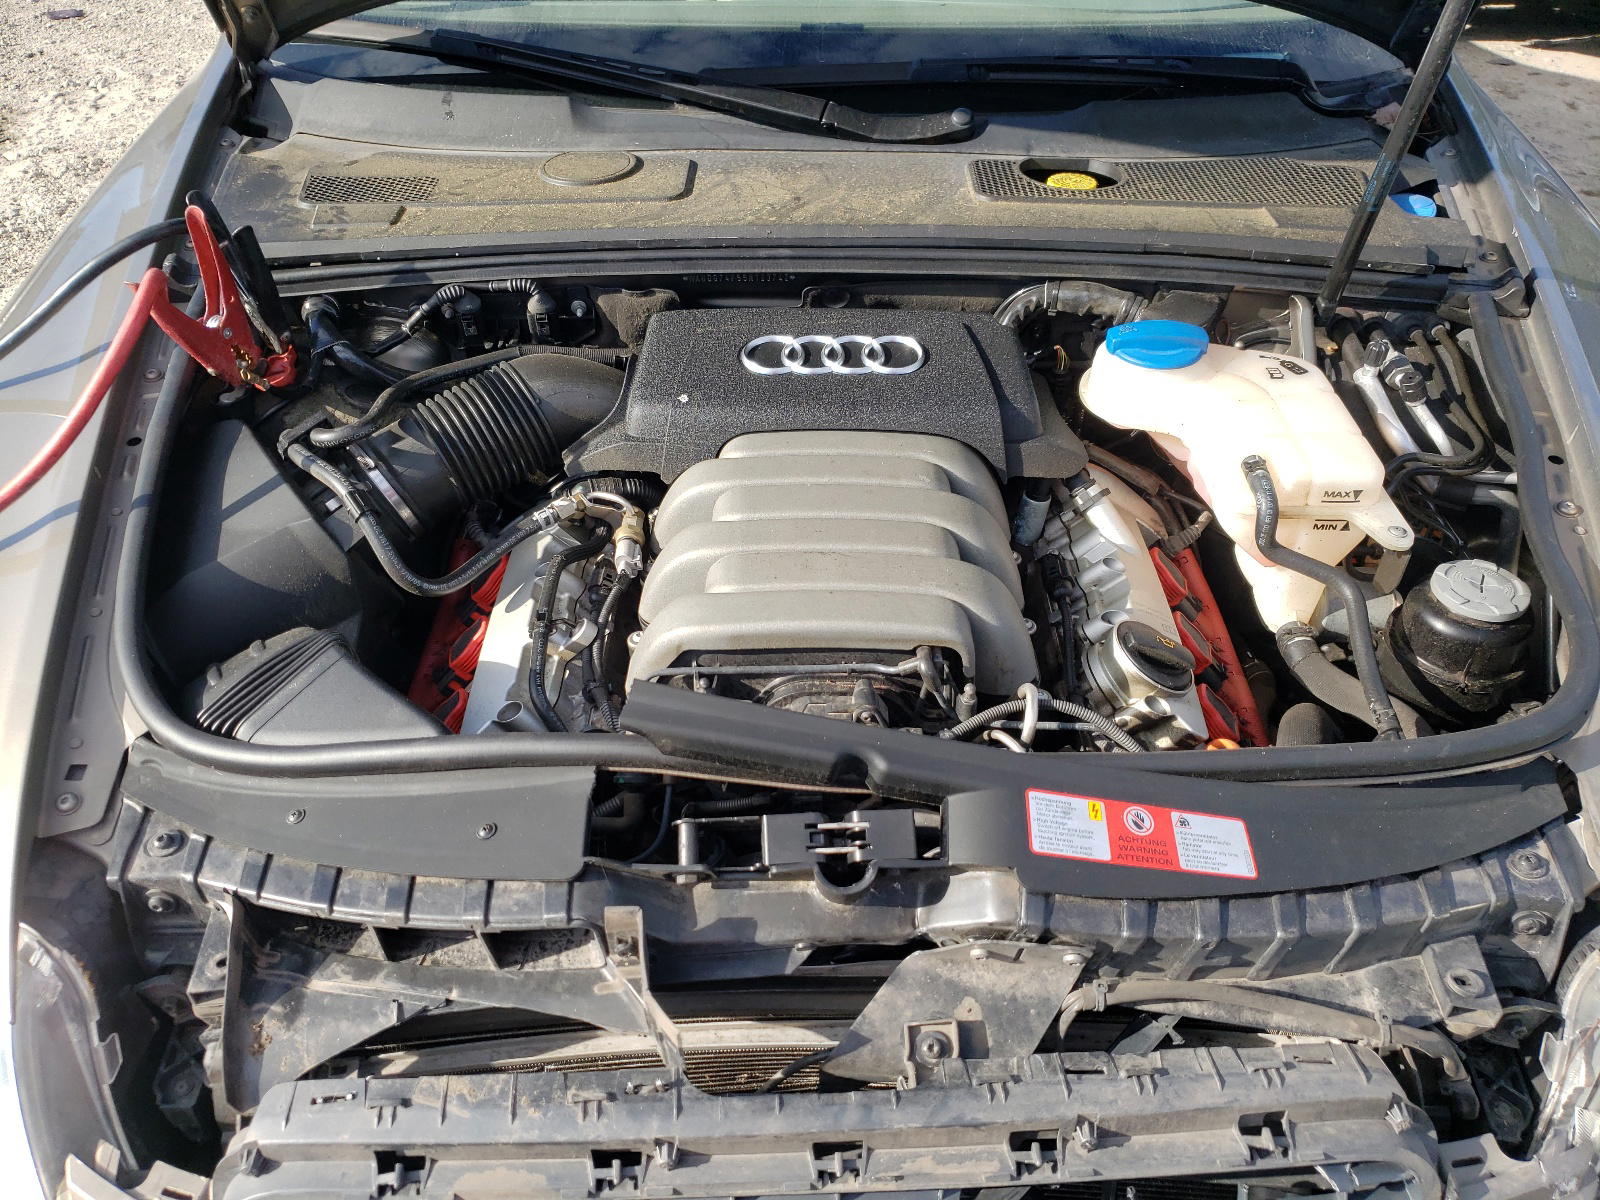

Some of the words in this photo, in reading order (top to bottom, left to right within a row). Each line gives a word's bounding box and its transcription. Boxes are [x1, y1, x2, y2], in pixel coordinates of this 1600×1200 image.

[1323, 490, 1352, 498] MAX
[1312, 523, 1338, 531] MIN
[1118, 835, 1167, 847] ACHTUNG
[1118, 844, 1169, 856] WARNING
[1117, 853, 1174, 866] ATTENTION
